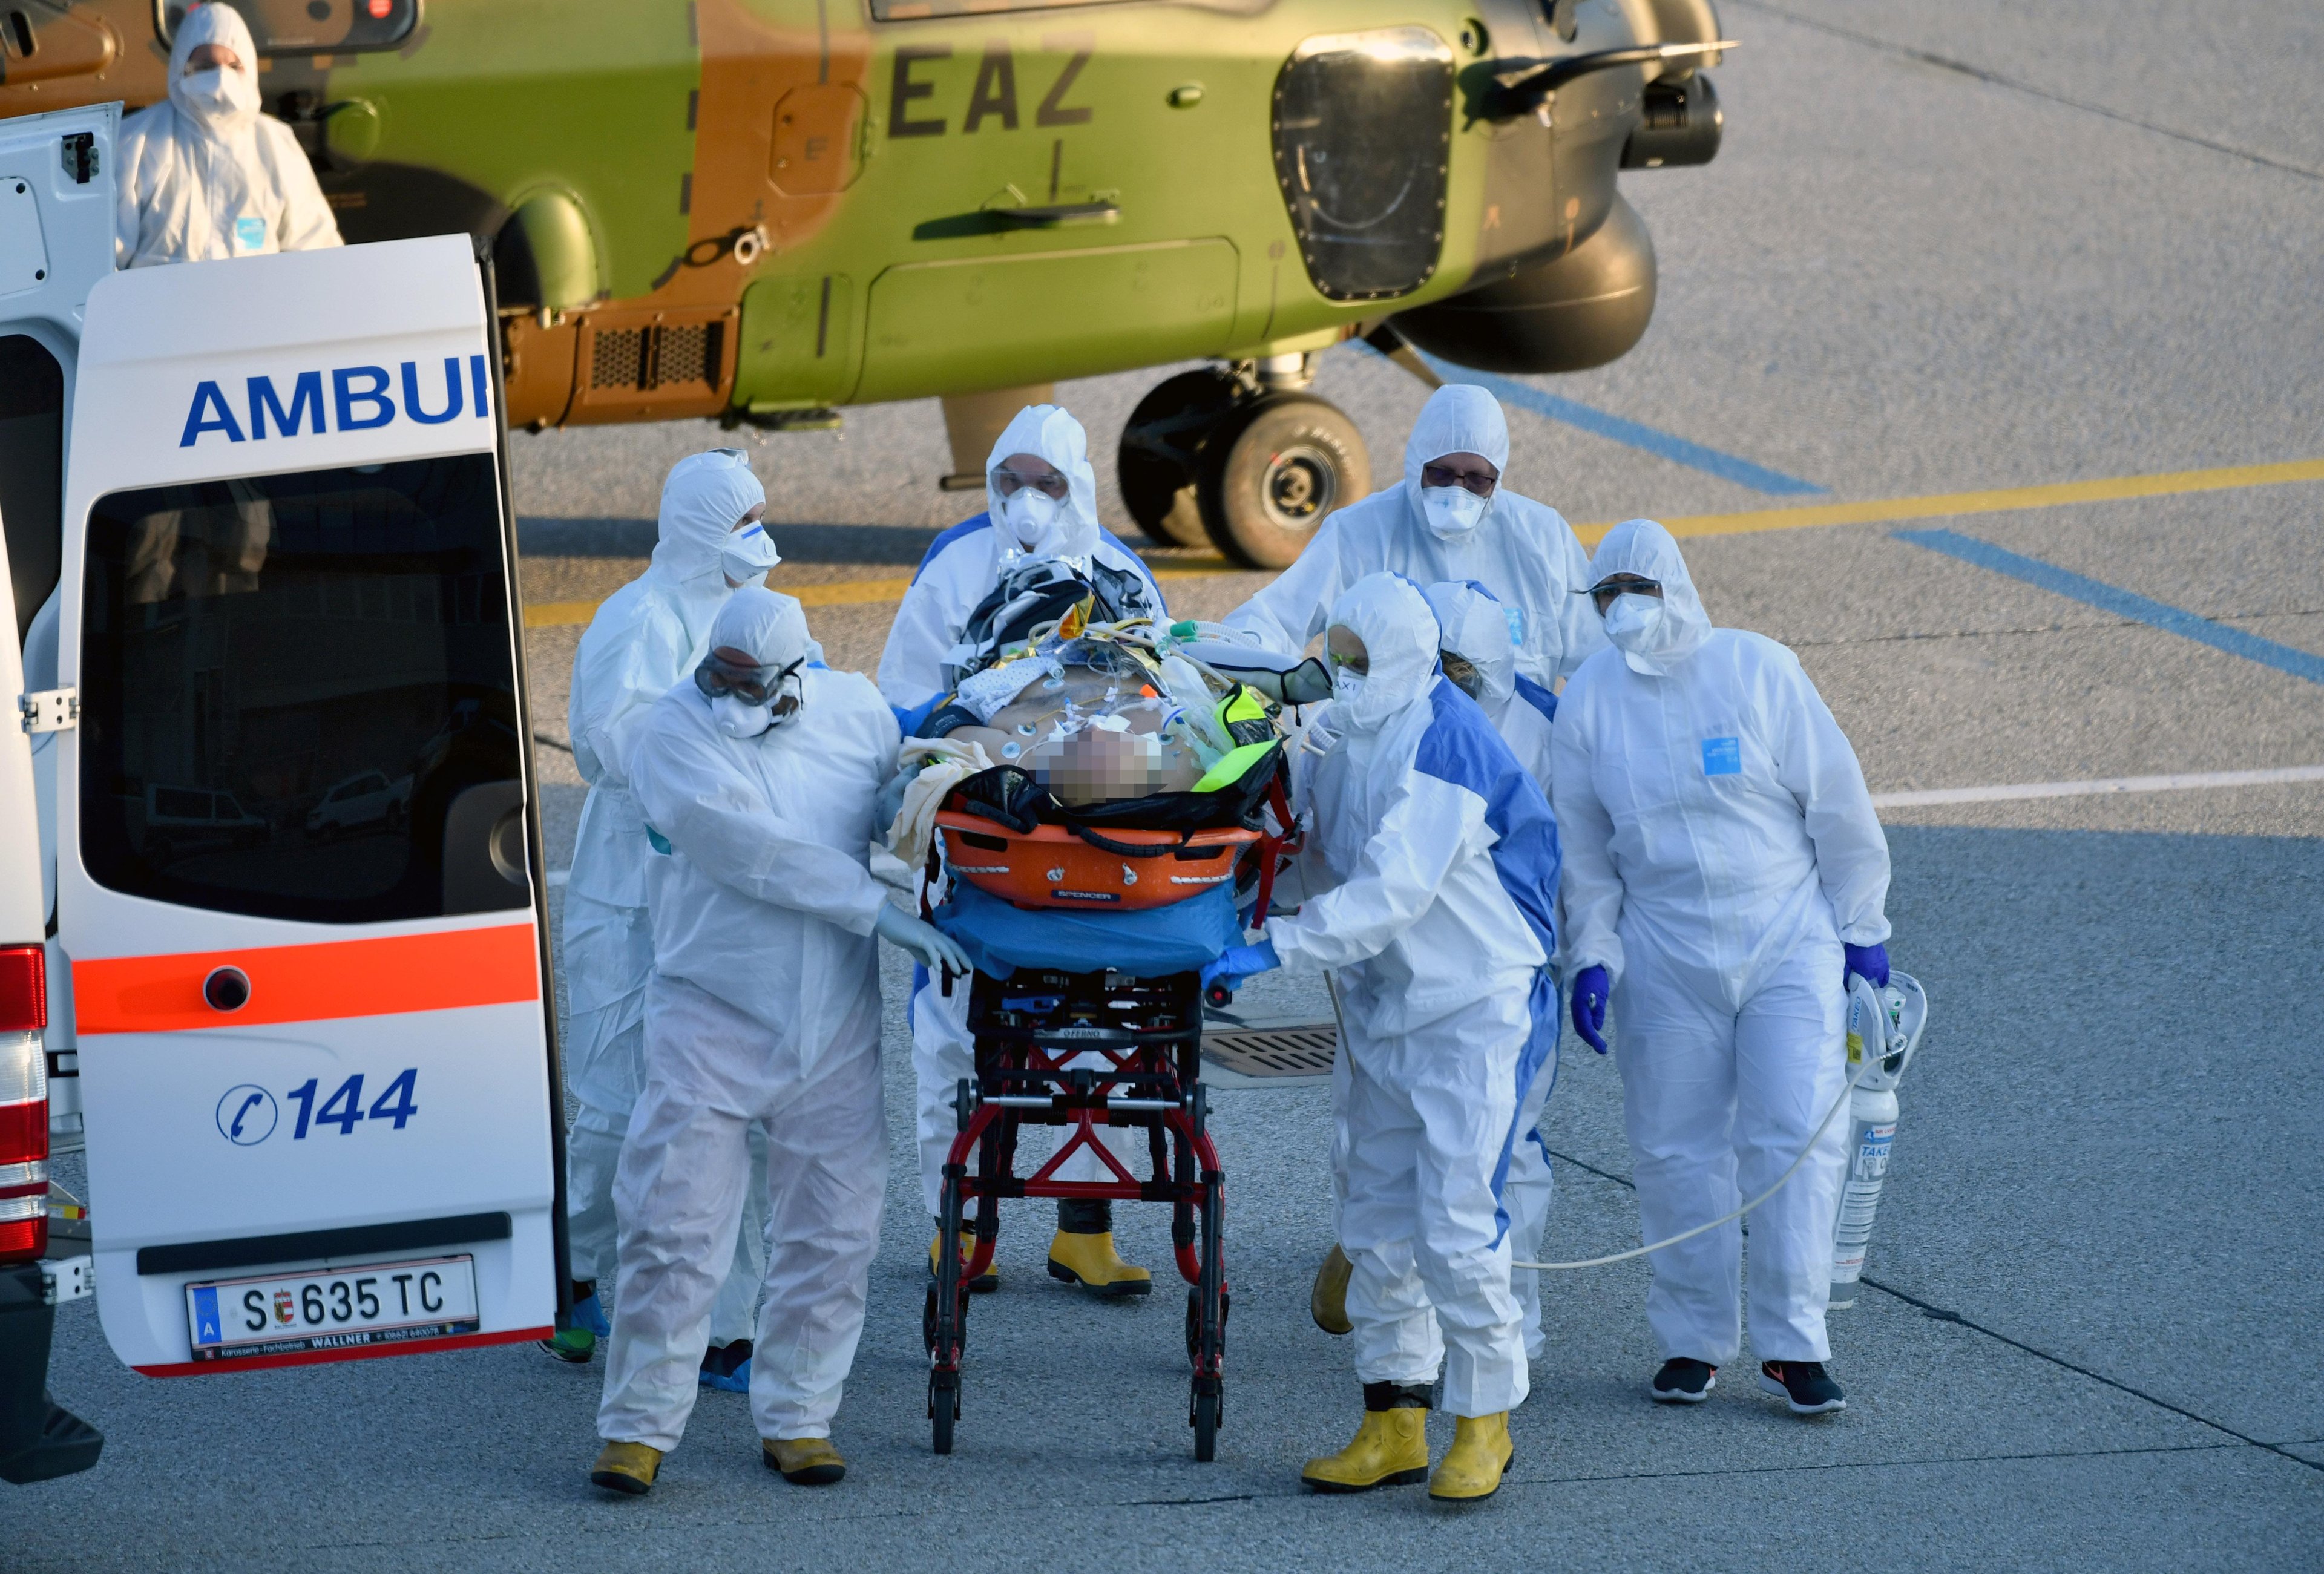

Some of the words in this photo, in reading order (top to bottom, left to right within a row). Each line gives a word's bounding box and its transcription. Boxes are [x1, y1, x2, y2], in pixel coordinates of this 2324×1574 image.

[887, 31, 1095, 139] EAZ
[1058, 890, 1111, 900] SPENCER
[287, 1067, 418, 1140] 144
[244, 1290, 267, 1331] S
[302, 1277, 380, 1325] 635
[392, 1272, 443, 1315] TC
[203, 1322, 215, 1336] A
[311, 1333, 370, 1349] WALLNER
